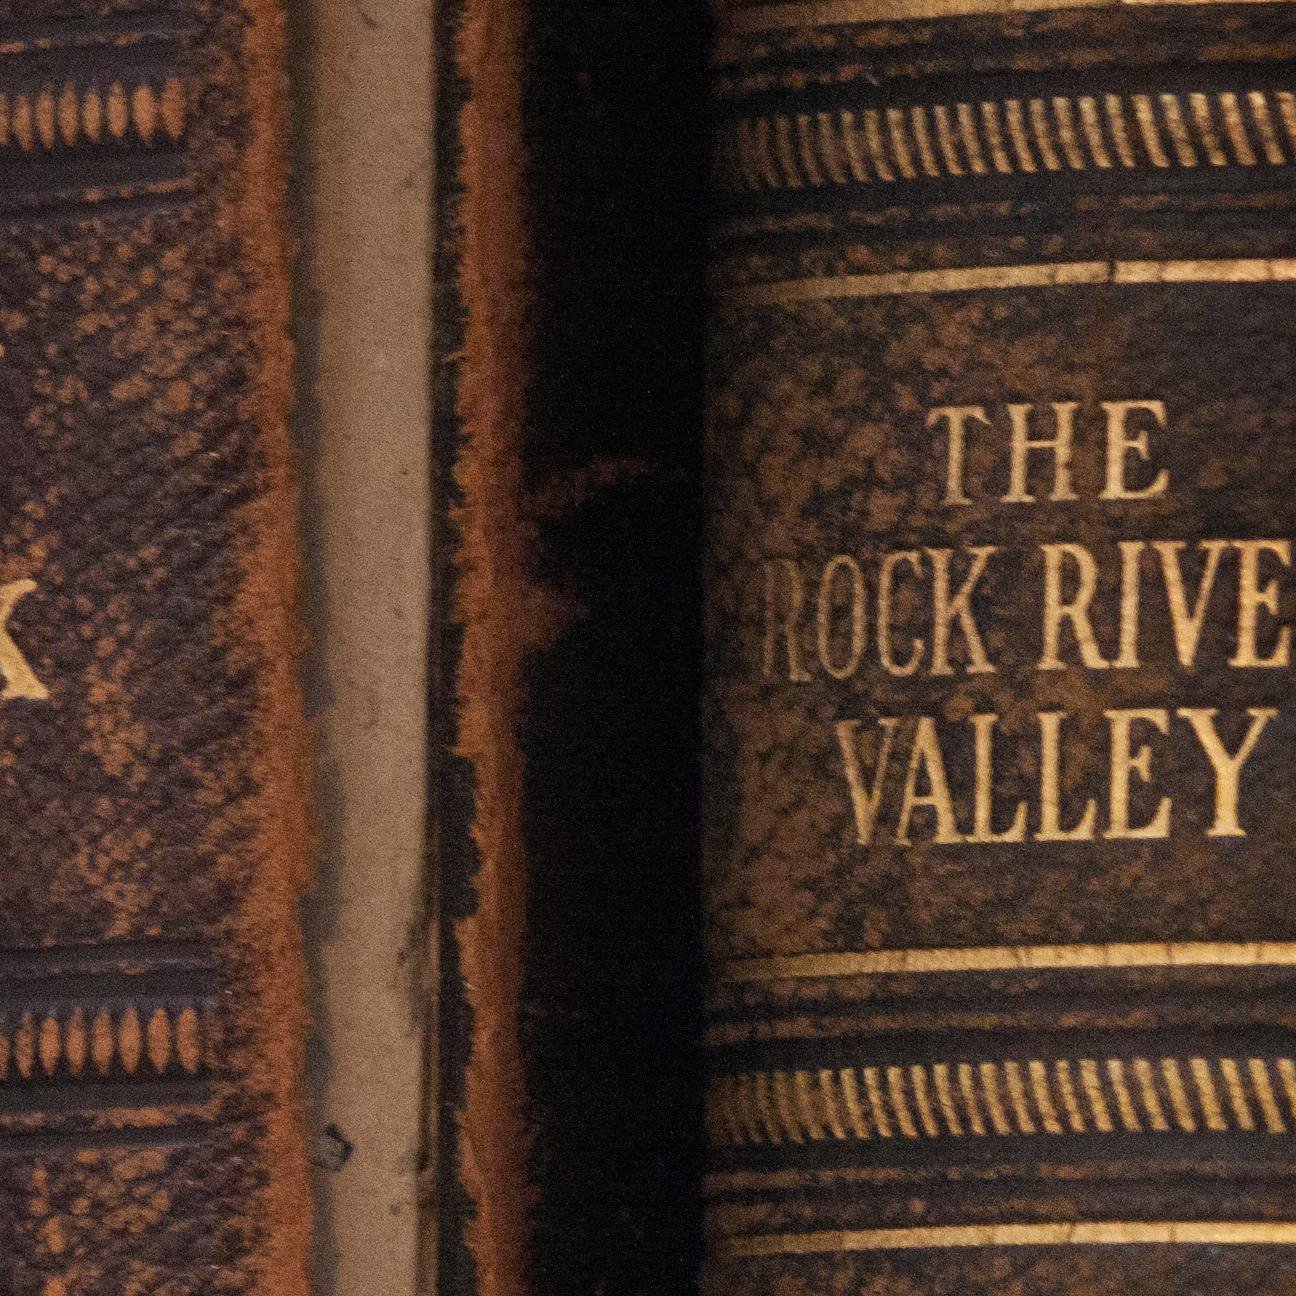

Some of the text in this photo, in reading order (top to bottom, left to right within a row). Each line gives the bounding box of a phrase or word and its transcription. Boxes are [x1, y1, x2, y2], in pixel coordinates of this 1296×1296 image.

[926, 398, 1171, 504] THE
[757, 544, 998, 684] ROCK
[834, 706, 1278, 848] VALLEY
